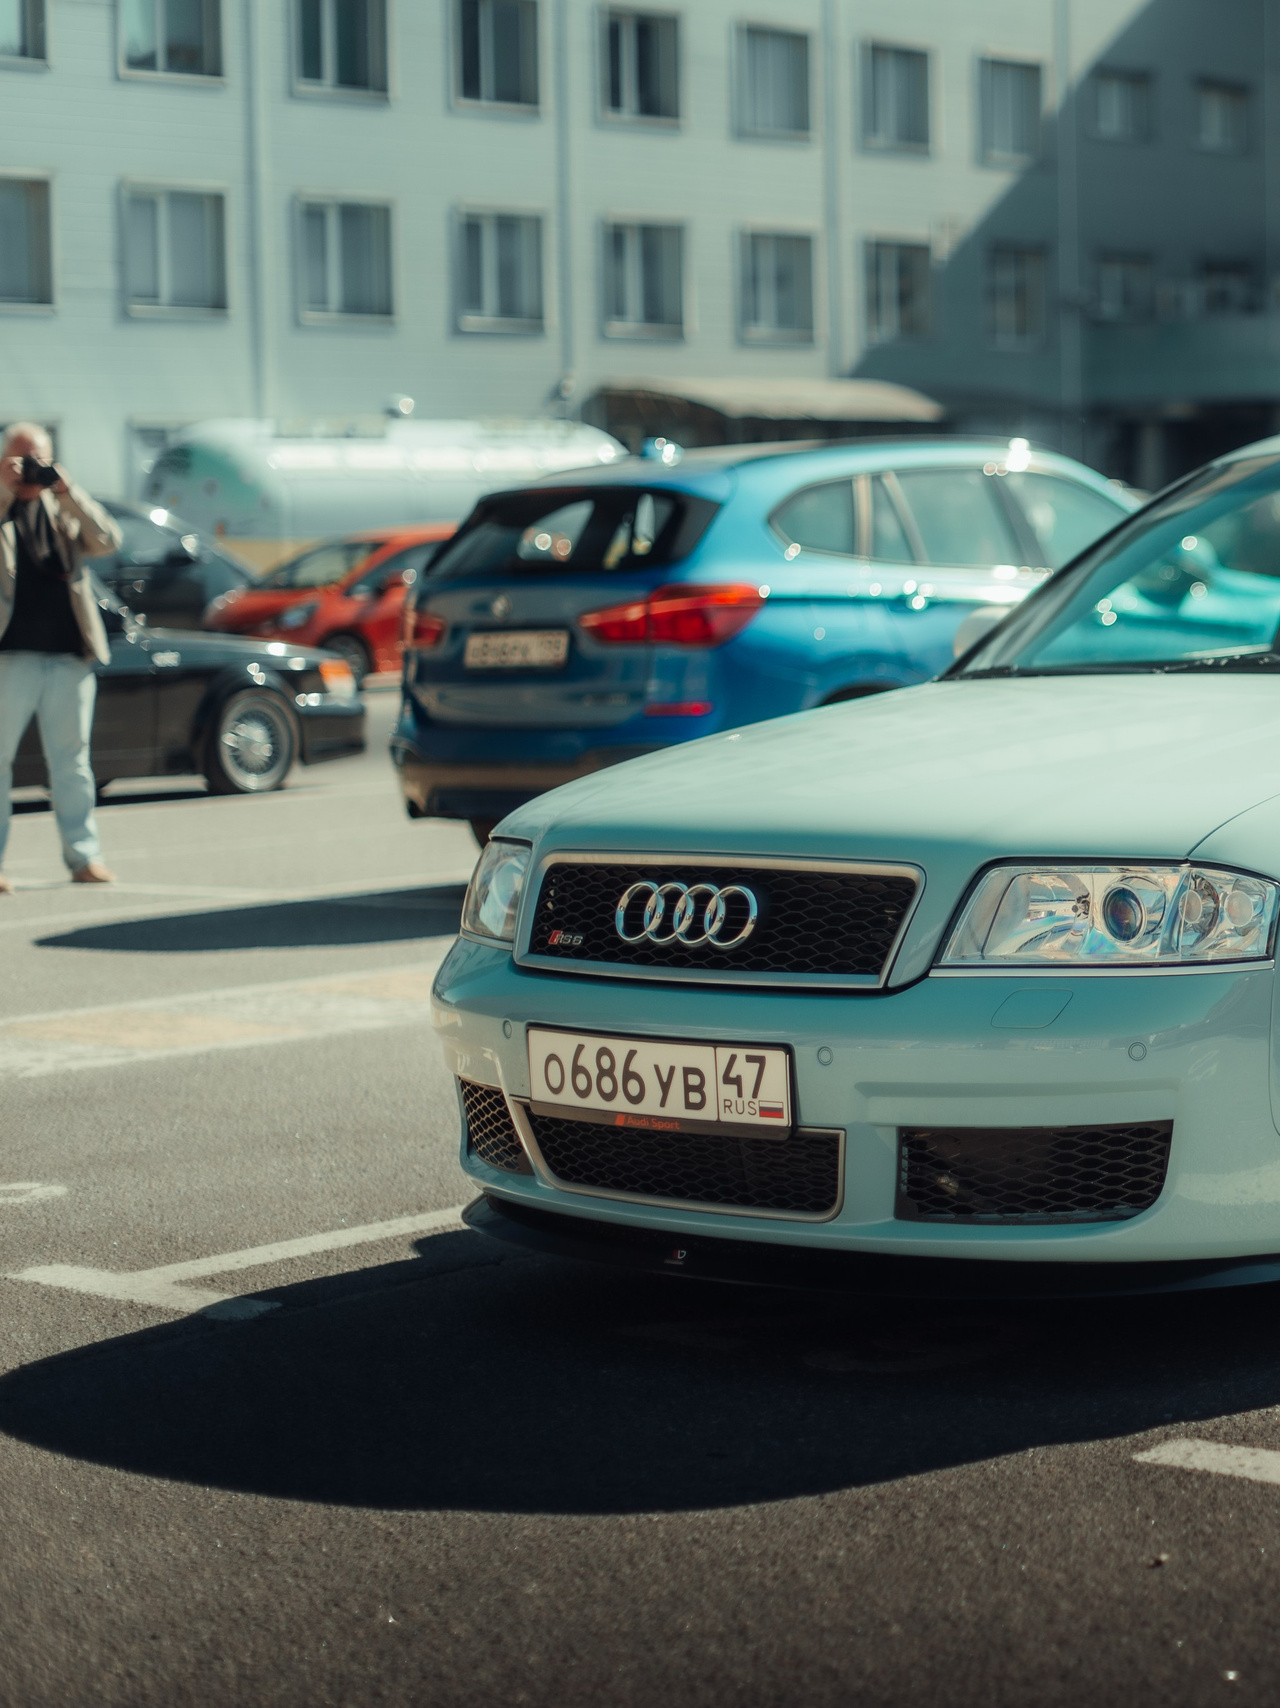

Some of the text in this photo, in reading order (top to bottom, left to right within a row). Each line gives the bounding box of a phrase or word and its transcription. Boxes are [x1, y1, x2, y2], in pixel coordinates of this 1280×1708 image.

[722, 1053, 766, 1099] 47
[723, 1098, 758, 1116] RUS
[627, 1116, 680, 1130] Audi Sport
